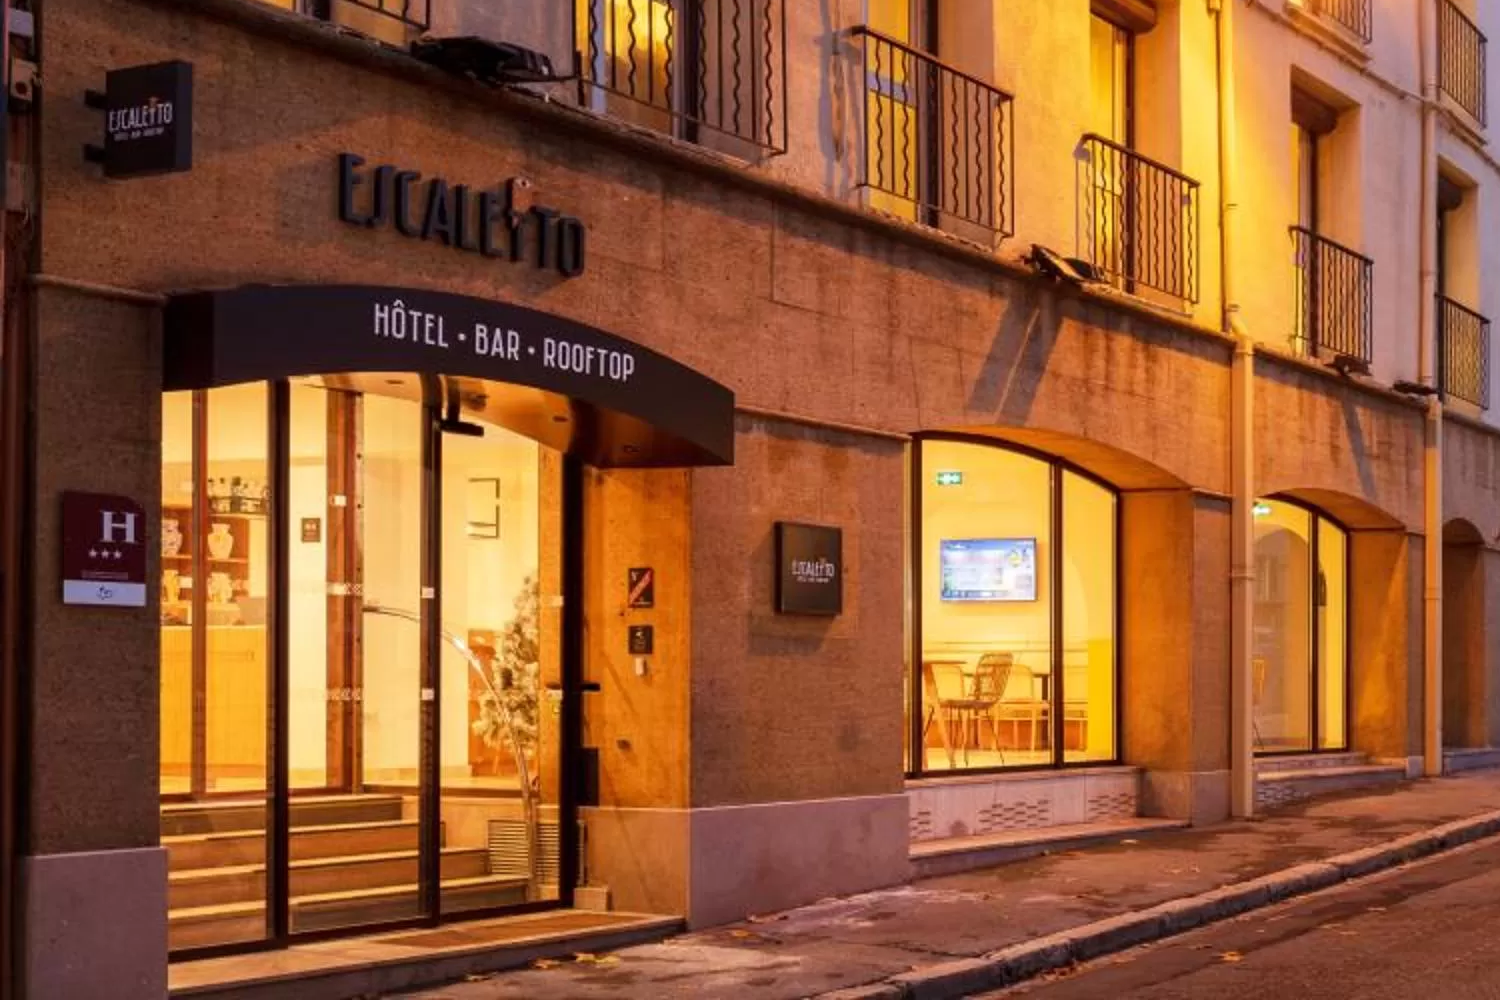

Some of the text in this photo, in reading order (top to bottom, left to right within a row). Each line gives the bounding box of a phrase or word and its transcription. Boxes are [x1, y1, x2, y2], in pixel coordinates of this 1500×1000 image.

[109, 99, 173, 132] ESCALETTO
[339, 153, 585, 278] ESCALETTO
[374, 299, 635, 382] HÔTEL BAR ROOFTOP
[100, 511, 138, 544] H
